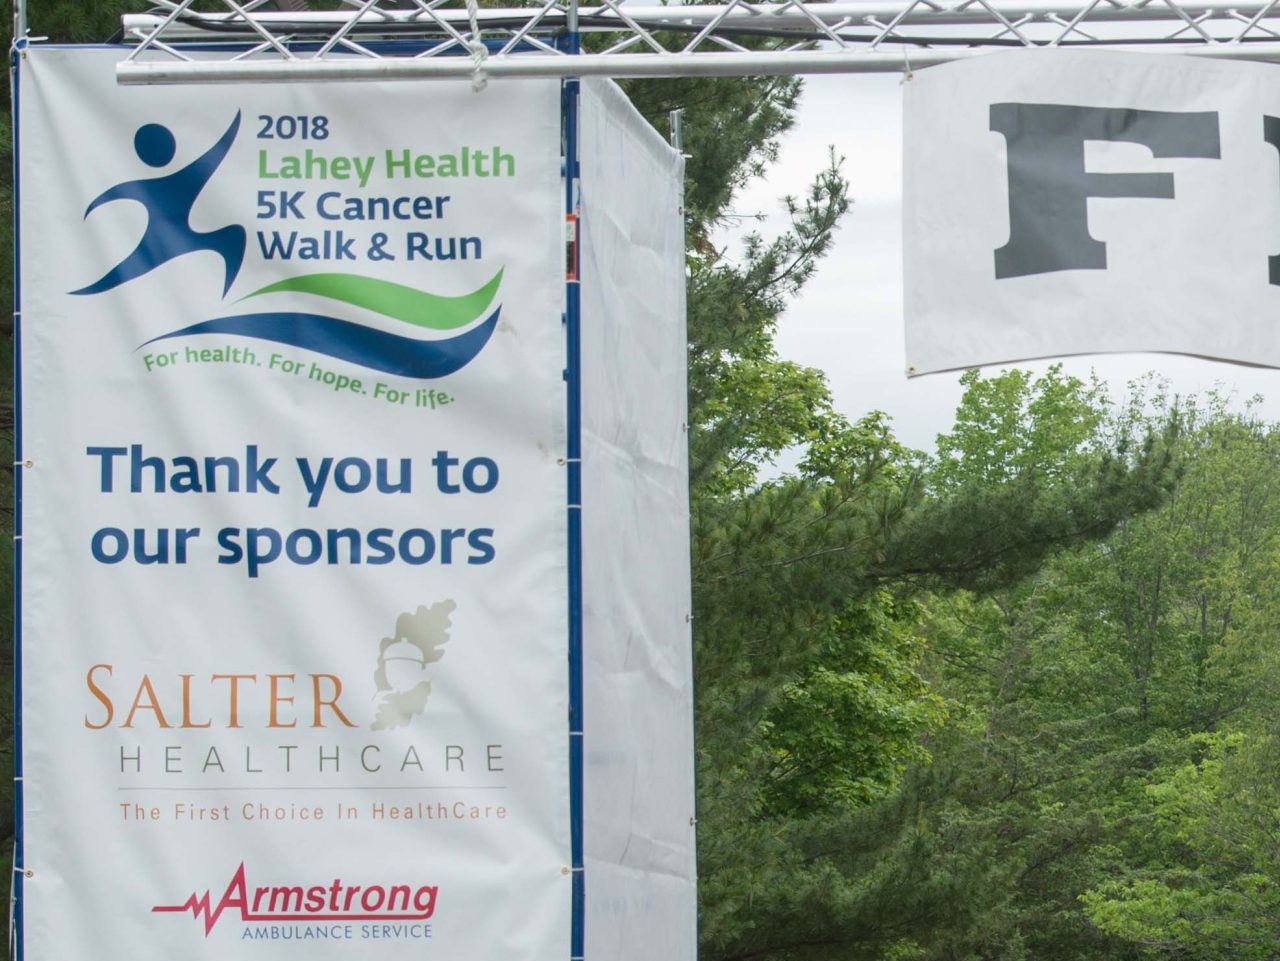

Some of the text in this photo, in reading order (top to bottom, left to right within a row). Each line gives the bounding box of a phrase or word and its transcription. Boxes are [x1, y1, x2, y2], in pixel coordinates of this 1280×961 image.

[256, 115, 330, 140] 2018
[258, 146, 516, 188] Lahey Health
[256, 190, 451, 220] 5K Cancer
[256, 230, 482, 261] Walk & Run
[143, 345, 455, 410] For health. For hope. For life.
[87, 444, 499, 508] Thank you to
[90, 524, 496, 578] our sponsors
[84, 664, 359, 730] SALTER
[120, 744, 505, 773] HEALTHCARE
[120, 802, 508, 821] The First Choice In HealthCare
[215, 861, 438, 917] Armstrong
[242, 925, 432, 940] AMBULANCE SERVICE
